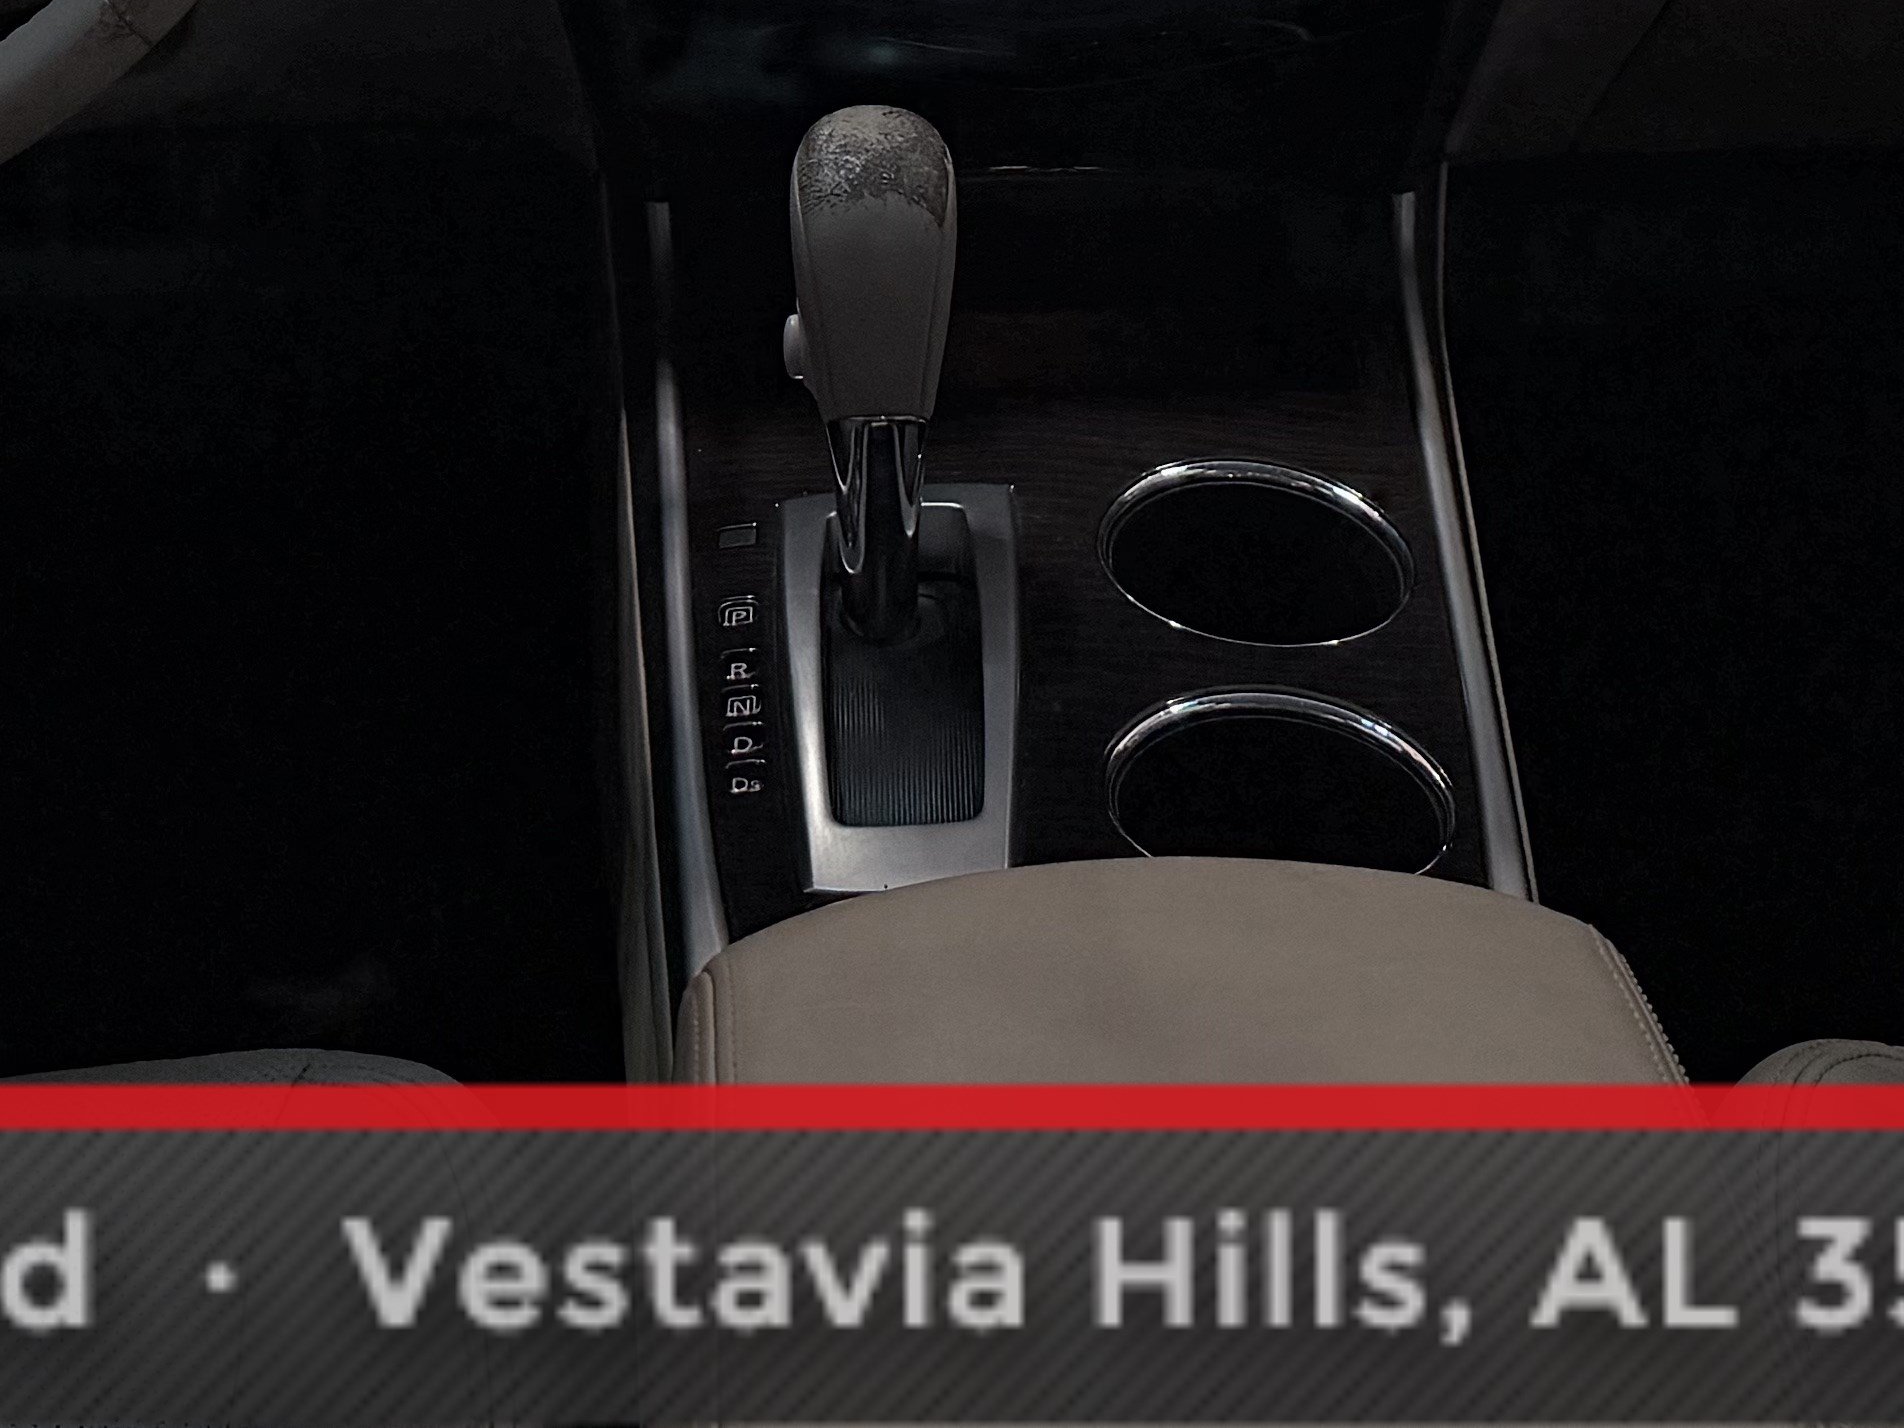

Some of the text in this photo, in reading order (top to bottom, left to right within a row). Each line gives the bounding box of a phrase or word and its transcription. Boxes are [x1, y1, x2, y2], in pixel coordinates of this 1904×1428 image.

[732, 611, 747, 624] P
[730, 662, 748, 679] R
[734, 700, 750, 715] N
